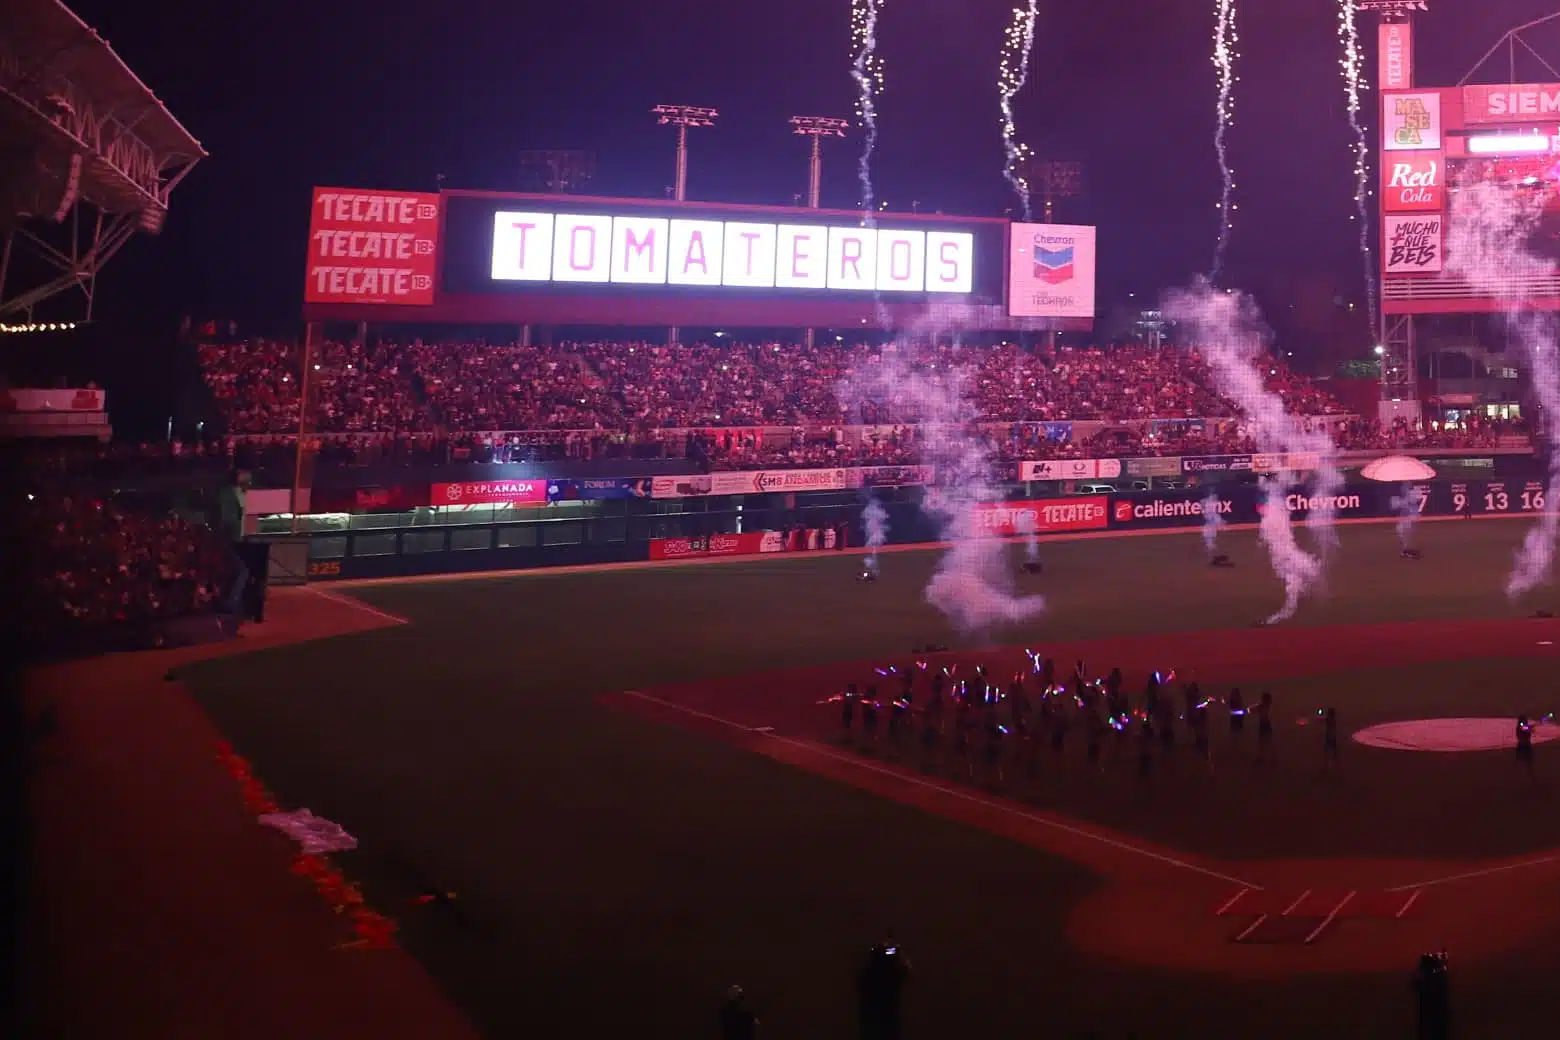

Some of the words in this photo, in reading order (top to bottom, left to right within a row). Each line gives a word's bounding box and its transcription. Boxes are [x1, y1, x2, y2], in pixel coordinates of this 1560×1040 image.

[1386, 160, 1438, 188] Red
[1401, 187, 1433, 203] Cola
[317, 193, 419, 224] TECATE
[1395, 221, 1439, 236] MUCHO
[313, 230, 417, 259] TECATE
[1033, 234, 1075, 245] Chevron
[1404, 235, 1431, 247] QUE
[511, 222, 961, 283] TOMATEROS
[1388, 244, 1437, 267] BEIS
[312, 266, 416, 295] TECATE
[465, 484, 534, 493] EXPLANADA
[1133, 499, 1233, 519] caliente.mx
[1285, 494, 1360, 511] Chevron
[1453, 493, 1466, 511] 9
[1484, 492, 1509, 510] 13
[1521, 491, 1545, 509] 16
[1041, 503, 1095, 523] TECATE
[308, 561, 341, 575] 325
